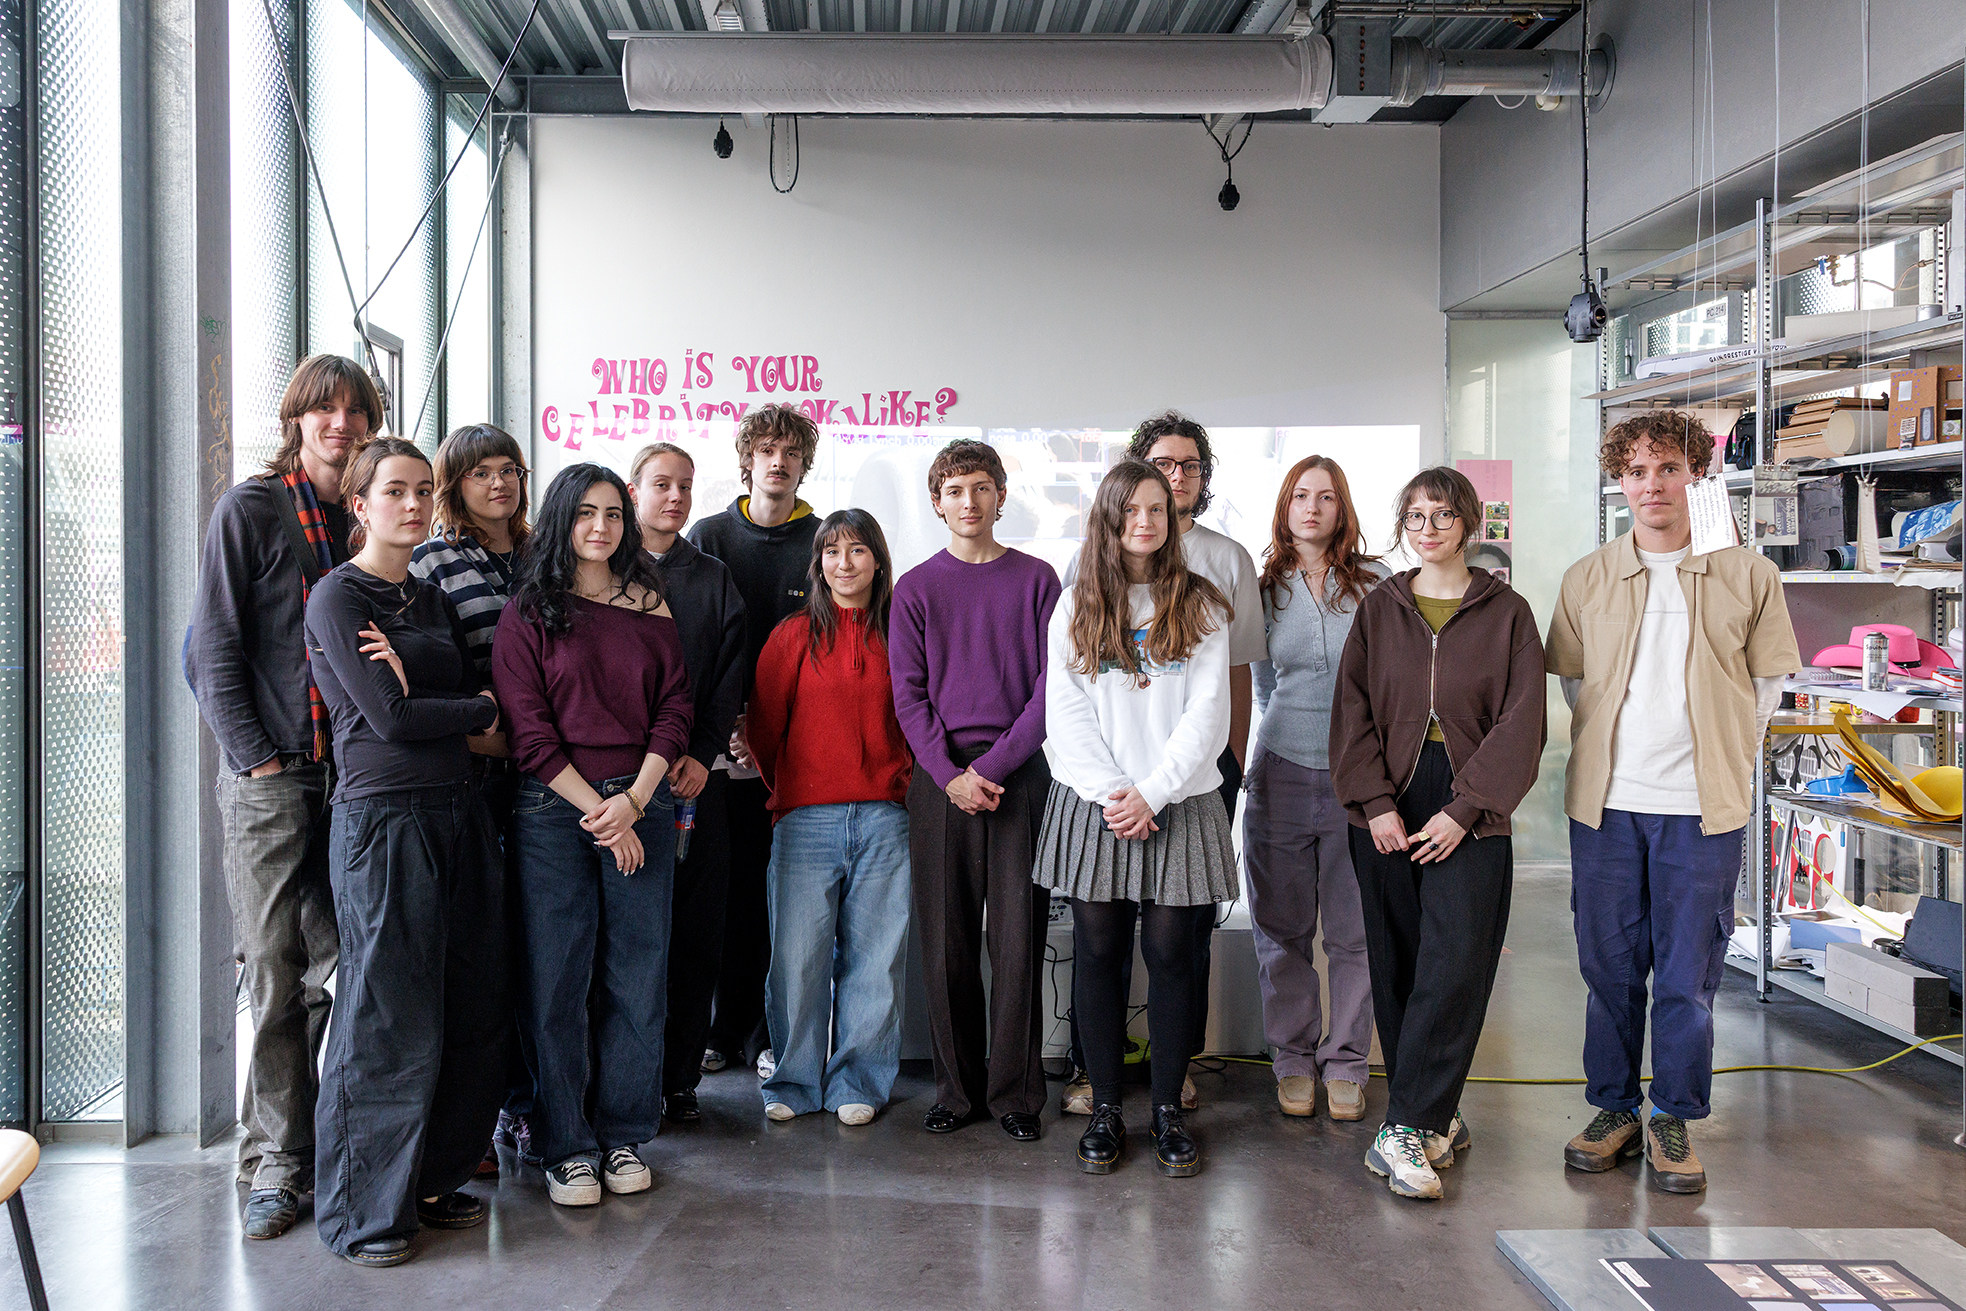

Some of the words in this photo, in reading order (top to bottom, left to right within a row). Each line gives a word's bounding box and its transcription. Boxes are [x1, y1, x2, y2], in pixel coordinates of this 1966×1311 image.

[591, 357, 667, 396] WHO
[682, 348, 714, 390] IS
[731, 354, 823, 394] YOUR
[542, 394, 750, 451] CELEBRITY
[764, 386, 957, 444] OKALIKE?
[869, 435, 902, 447] Lynch
[988, 434, 1016, 443] nose
[1021, 432, 1048, 443] 0.00
